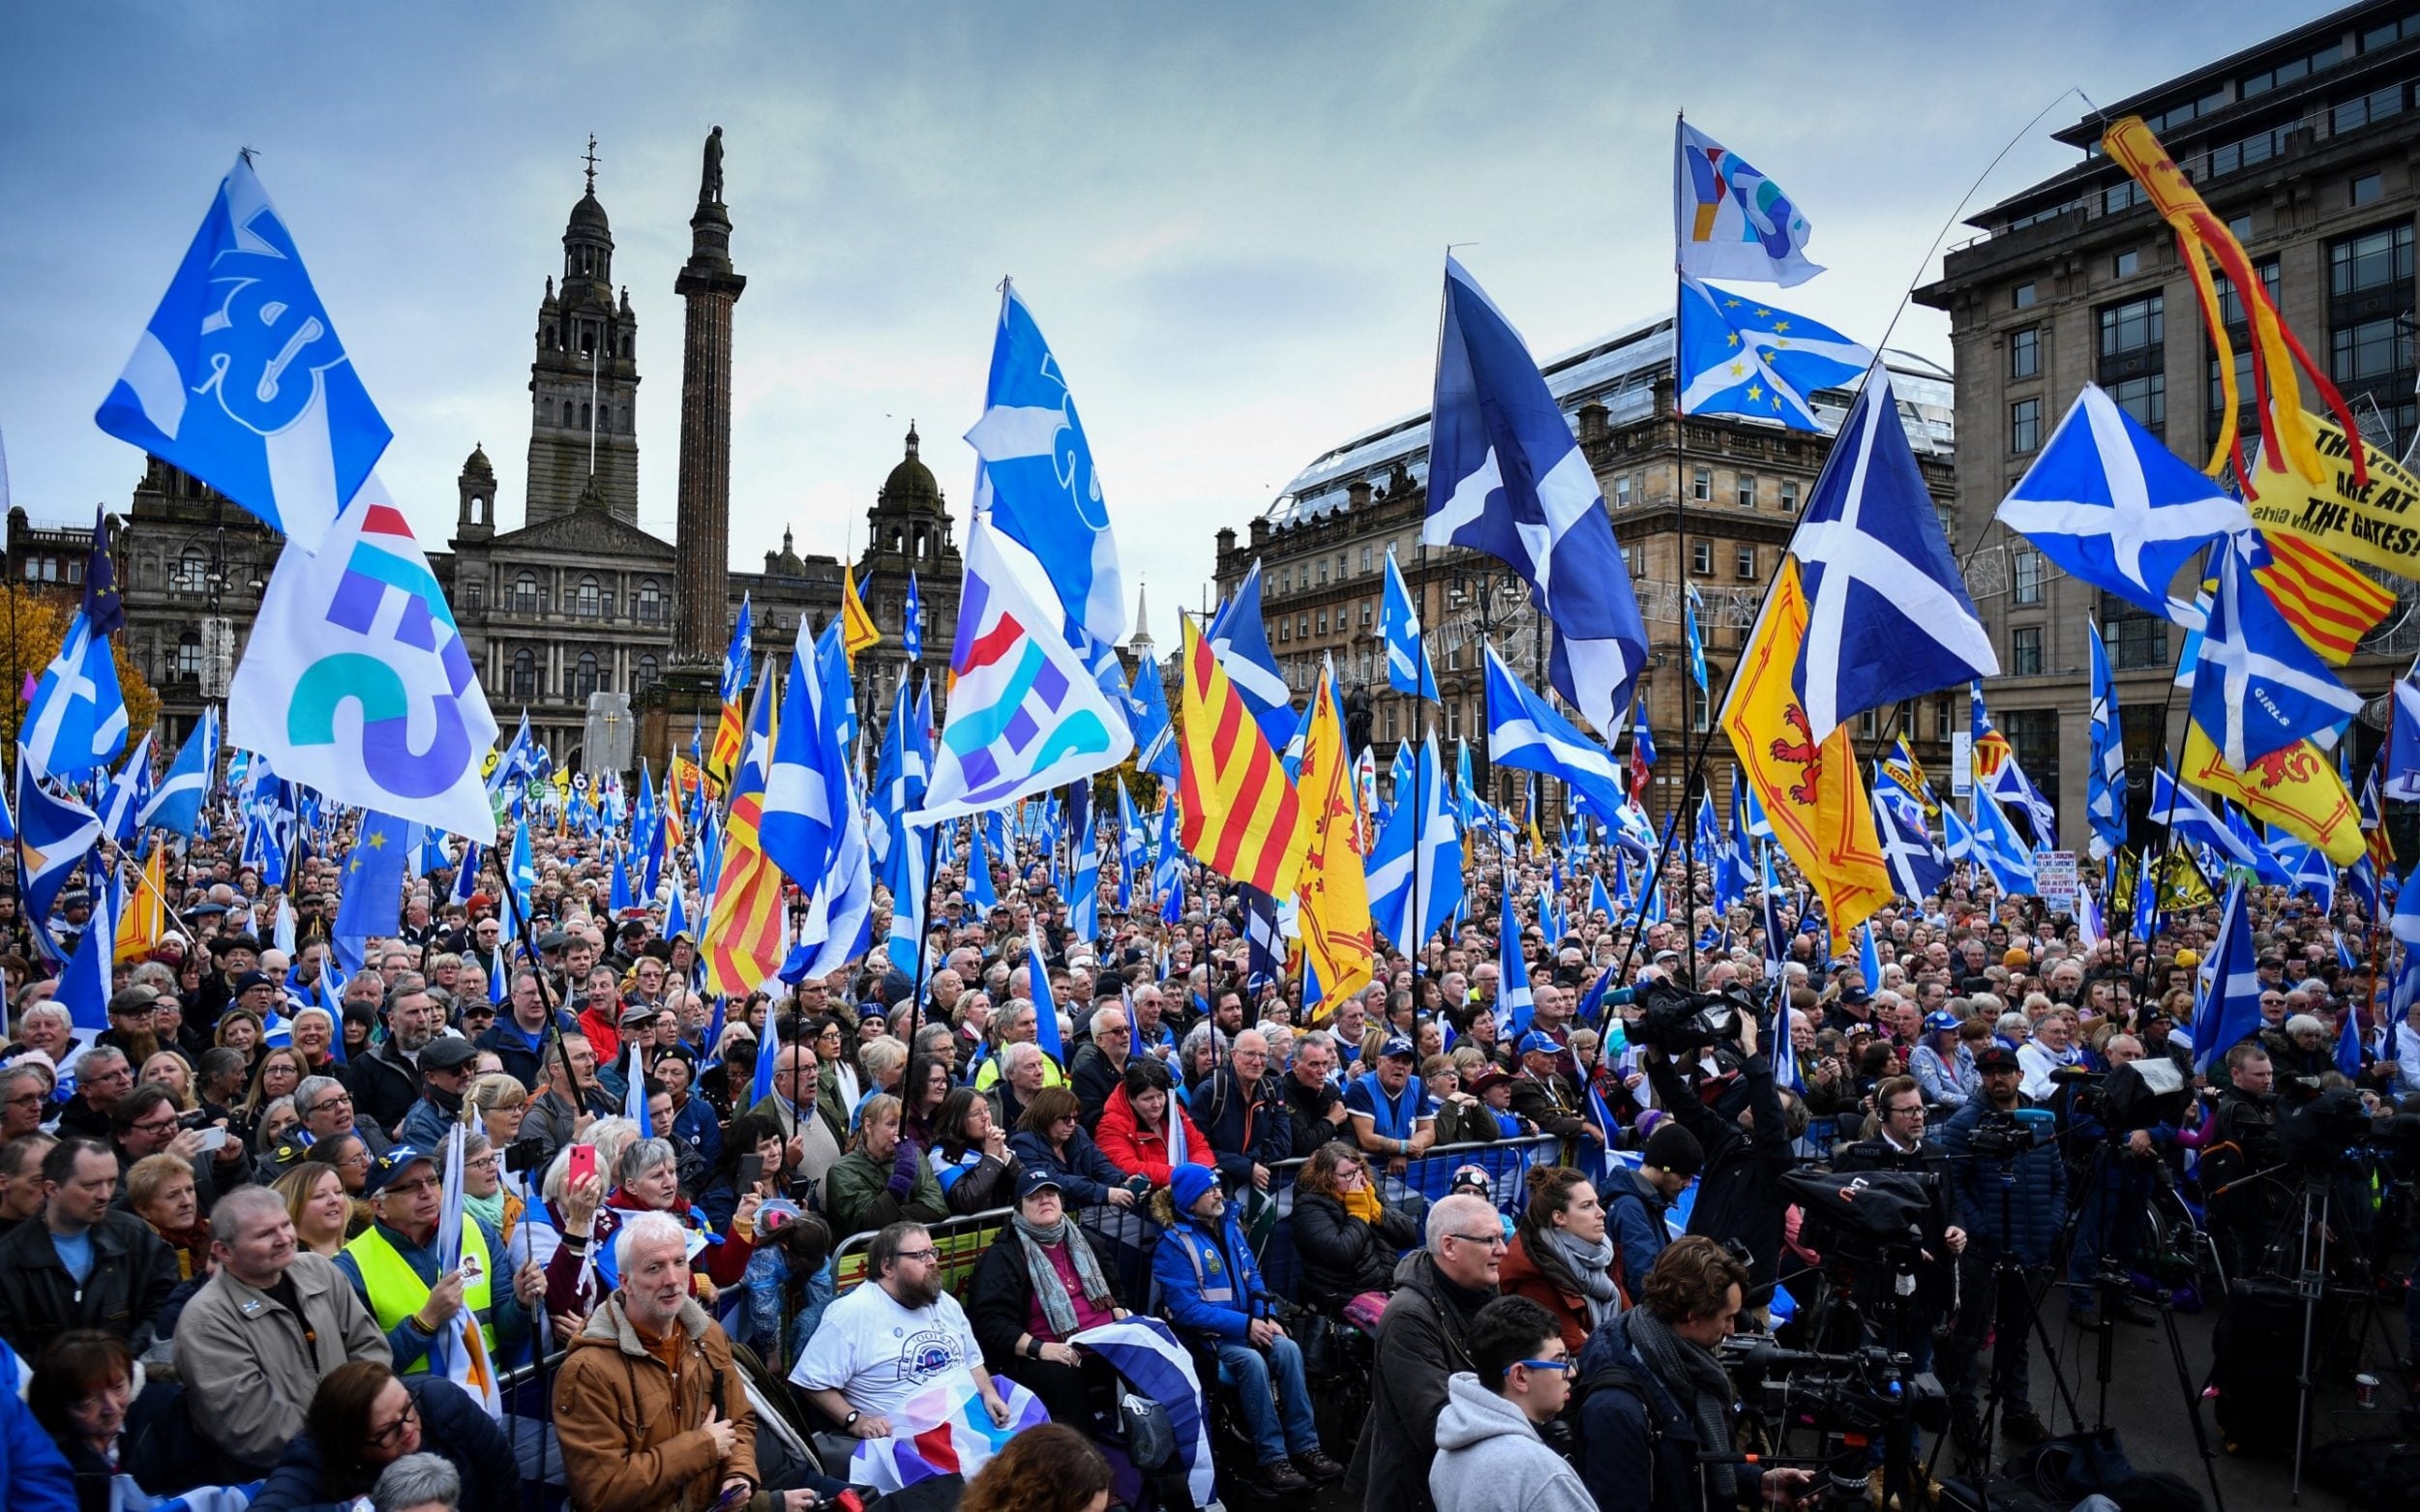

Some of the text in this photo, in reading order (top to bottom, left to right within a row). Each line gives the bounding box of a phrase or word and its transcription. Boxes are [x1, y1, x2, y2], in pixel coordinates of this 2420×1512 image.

[2302, 496, 2349, 533] THE
[2374, 486, 2419, 515] AT
[2255, 687, 2290, 726] GIRLS
